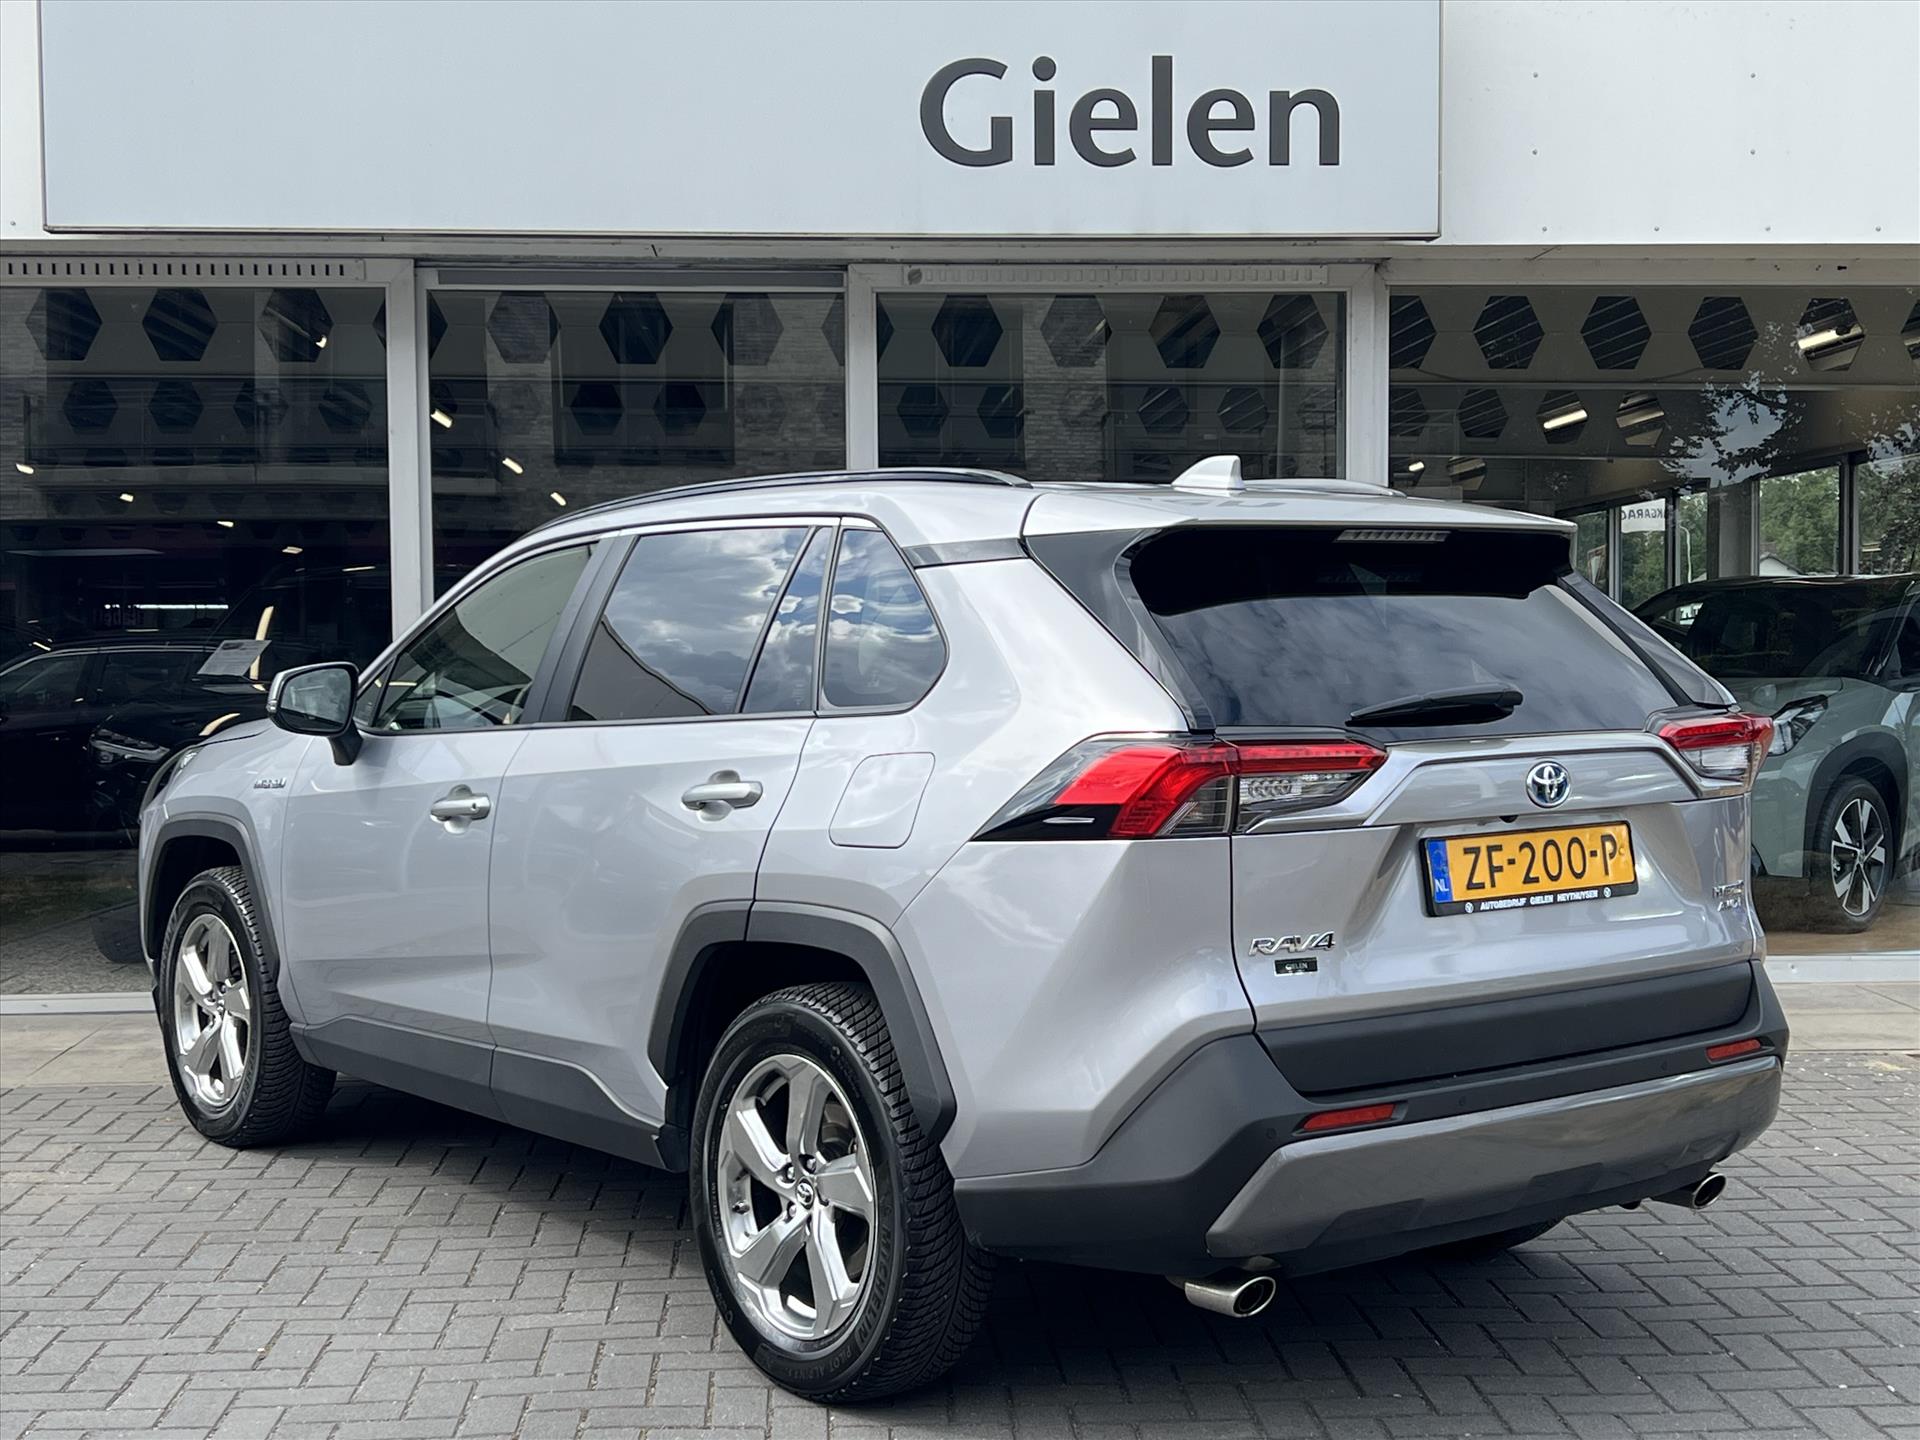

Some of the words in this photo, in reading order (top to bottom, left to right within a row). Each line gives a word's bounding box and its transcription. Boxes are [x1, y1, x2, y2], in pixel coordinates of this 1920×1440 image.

[920, 55, 1340, 167] Gielen
[1463, 833, 1618, 890] ZF-200-P
[1434, 879, 1449, 892] NL
[1530, 895, 1553, 905] GIELEN
[1249, 931, 1336, 955] RAV4
